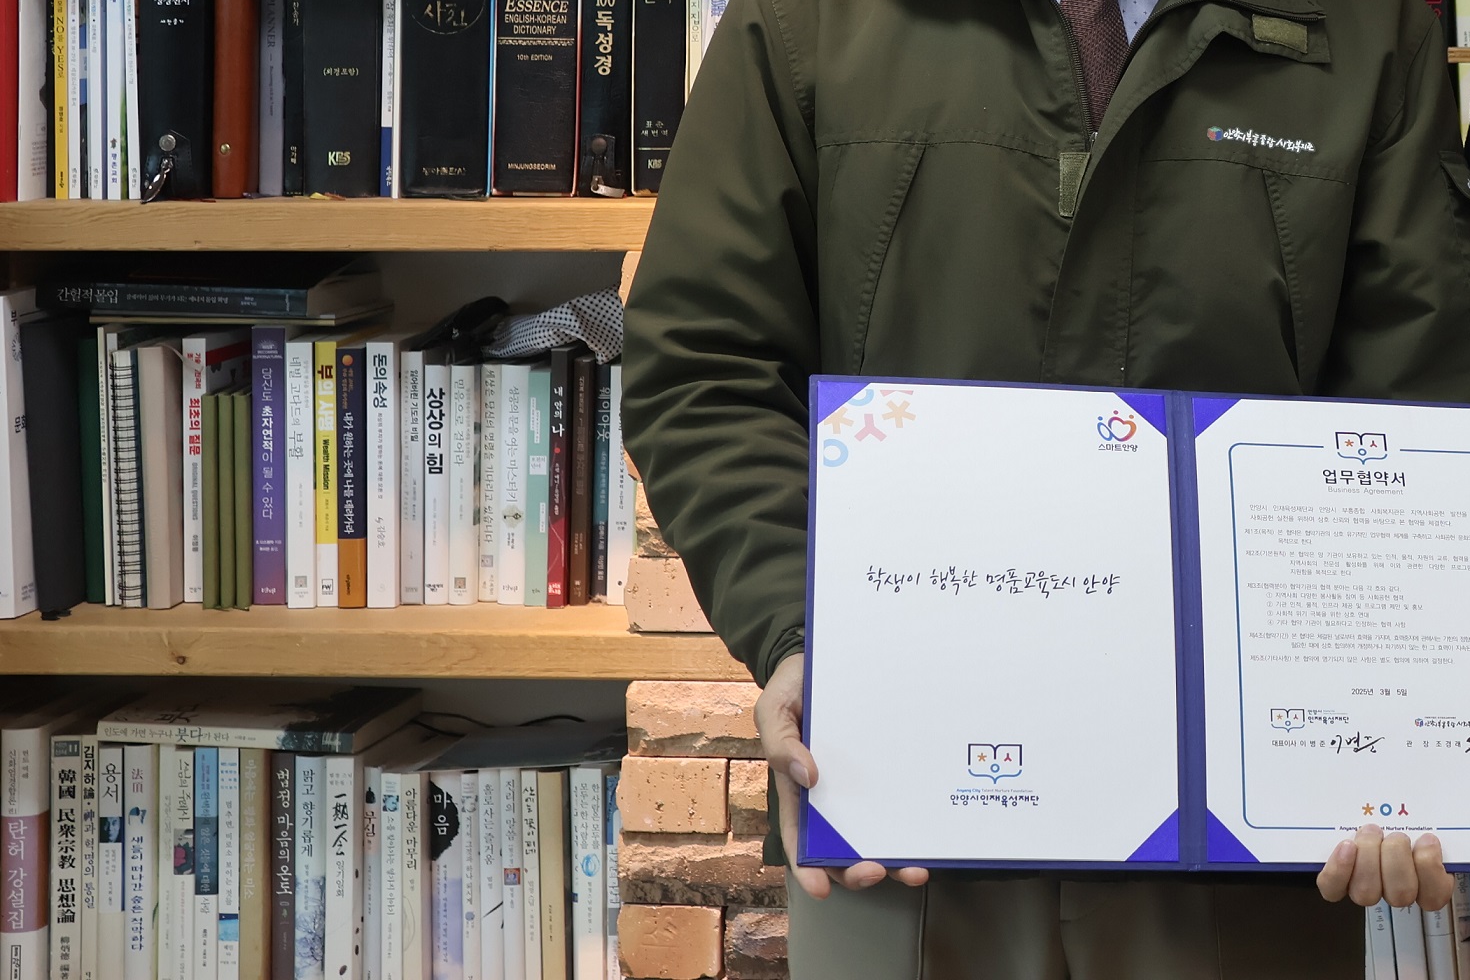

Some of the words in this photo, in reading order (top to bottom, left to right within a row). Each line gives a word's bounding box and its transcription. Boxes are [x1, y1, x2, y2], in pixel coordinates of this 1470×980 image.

[504, 14, 567, 24] ENGLISH-KOREAN
[513, 24, 557, 35] DICTIONARY
[507, 163, 557, 171] MINJUNGSEORIM
[374, 354, 387, 380] 돈의
[374, 383, 387, 408] 속성
[426, 388, 445, 449] 상상의
[1098, 443, 1138, 452] 스마트안양
[426, 454, 444, 475] 힘
[1323, 469, 1407, 487] 업무협약서
[1328, 486, 1359, 494] Business
[1363, 487, 1403, 495] Agreement
[866, 565, 921, 593] 학생이
[929, 566, 978, 595] 행복한
[986, 569, 1076, 599] 명품교육도시
[1082, 573, 1121, 594] 안양
[1380, 688, 1390, 696] 3월
[58, 770, 76, 800] 韓國
[102, 764, 121, 803] 용서
[276, 769, 290, 809] 법정
[302, 769, 315, 795] 맑고
[950, 794, 1039, 807] 안양시인재육성재단
[8, 821, 27, 860] 탄허
[276, 817, 292, 860] 마음의
[276, 866, 292, 895] 온도
[7, 868, 26, 930] 강설집
[57, 879, 75, 924] 思想論
